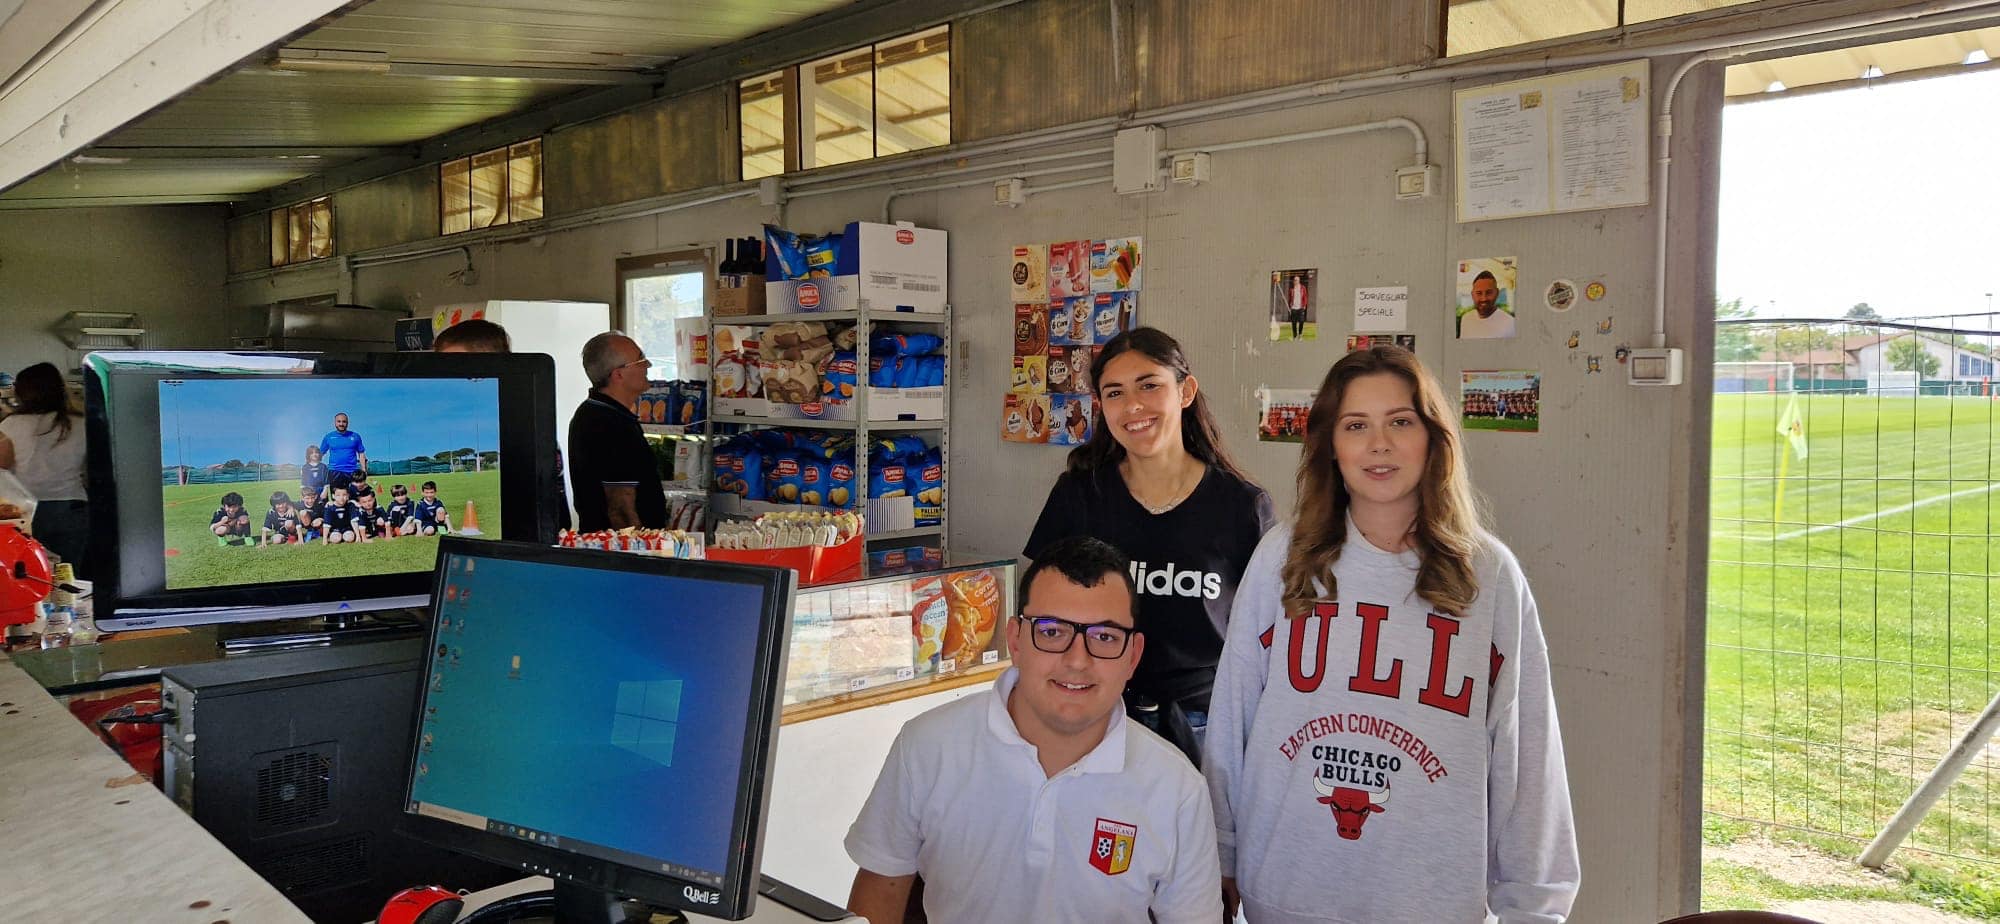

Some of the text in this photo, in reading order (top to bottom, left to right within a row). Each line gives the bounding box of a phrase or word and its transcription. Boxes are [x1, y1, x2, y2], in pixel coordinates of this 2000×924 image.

[1129, 560, 1222, 600] idas
[1259, 602, 1505, 718] ULL
[1278, 713, 1448, 784] EASTERN CONFERENCE
[1311, 744, 1402, 772] CHICAGO
[1322, 763, 1386, 788] BULLS
